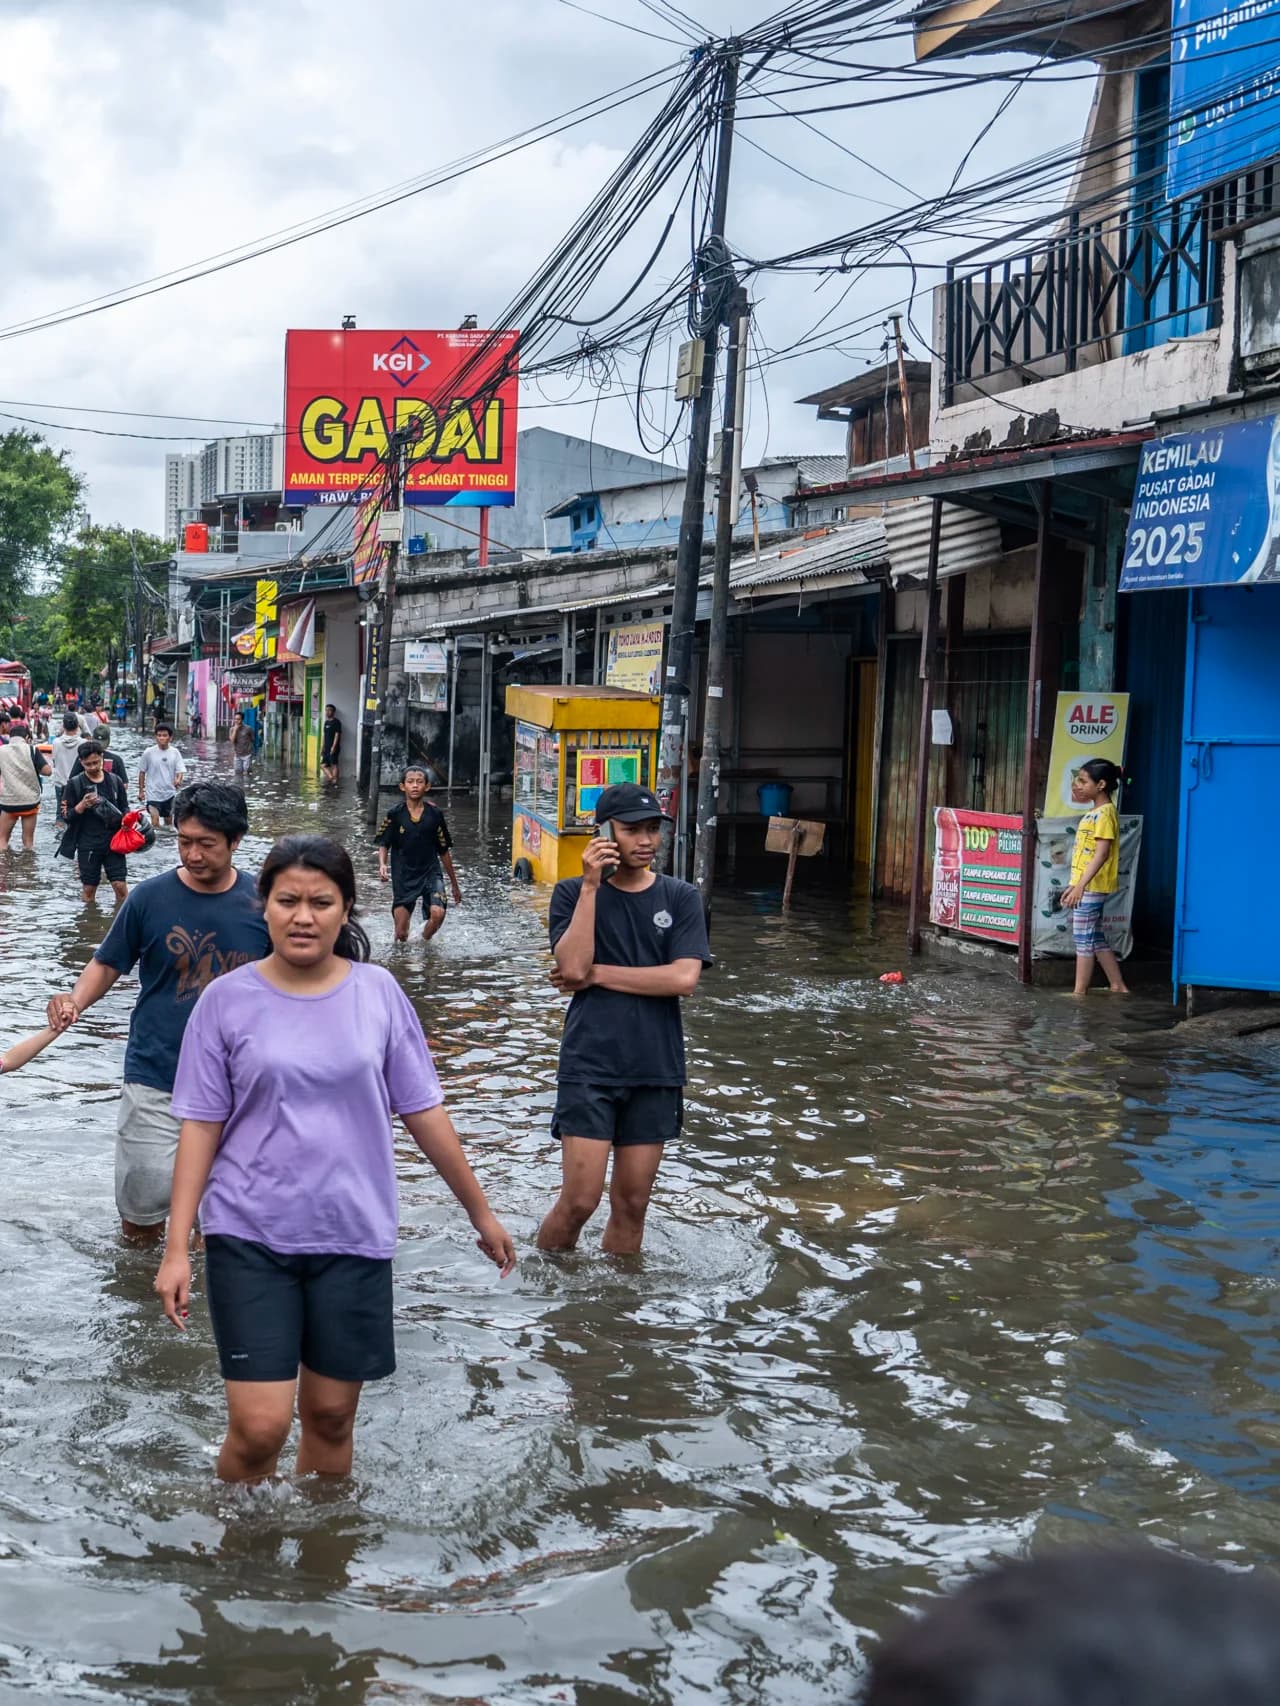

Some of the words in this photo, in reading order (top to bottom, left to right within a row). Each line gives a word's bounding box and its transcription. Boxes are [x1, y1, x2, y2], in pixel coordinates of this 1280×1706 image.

[372, 353, 413, 372] KGI
[300, 396, 503, 465] GADAI
[1142, 439, 1224, 475] KEMILAU
[290, 473, 325, 485] AMAN
[419, 474, 464, 486] SANGAT
[468, 474, 509, 487] TINGGI
[1138, 478, 1176, 499] PUSAT
[1177, 471, 1216, 493] GADAI
[1135, 493, 1210, 519] INDONESIA
[1126, 521, 1206, 568] 2025
[1069, 704, 1115, 724] ALE
[1070, 724, 1109, 735] DRINK
[998, 838, 1022, 852] PILIHA
